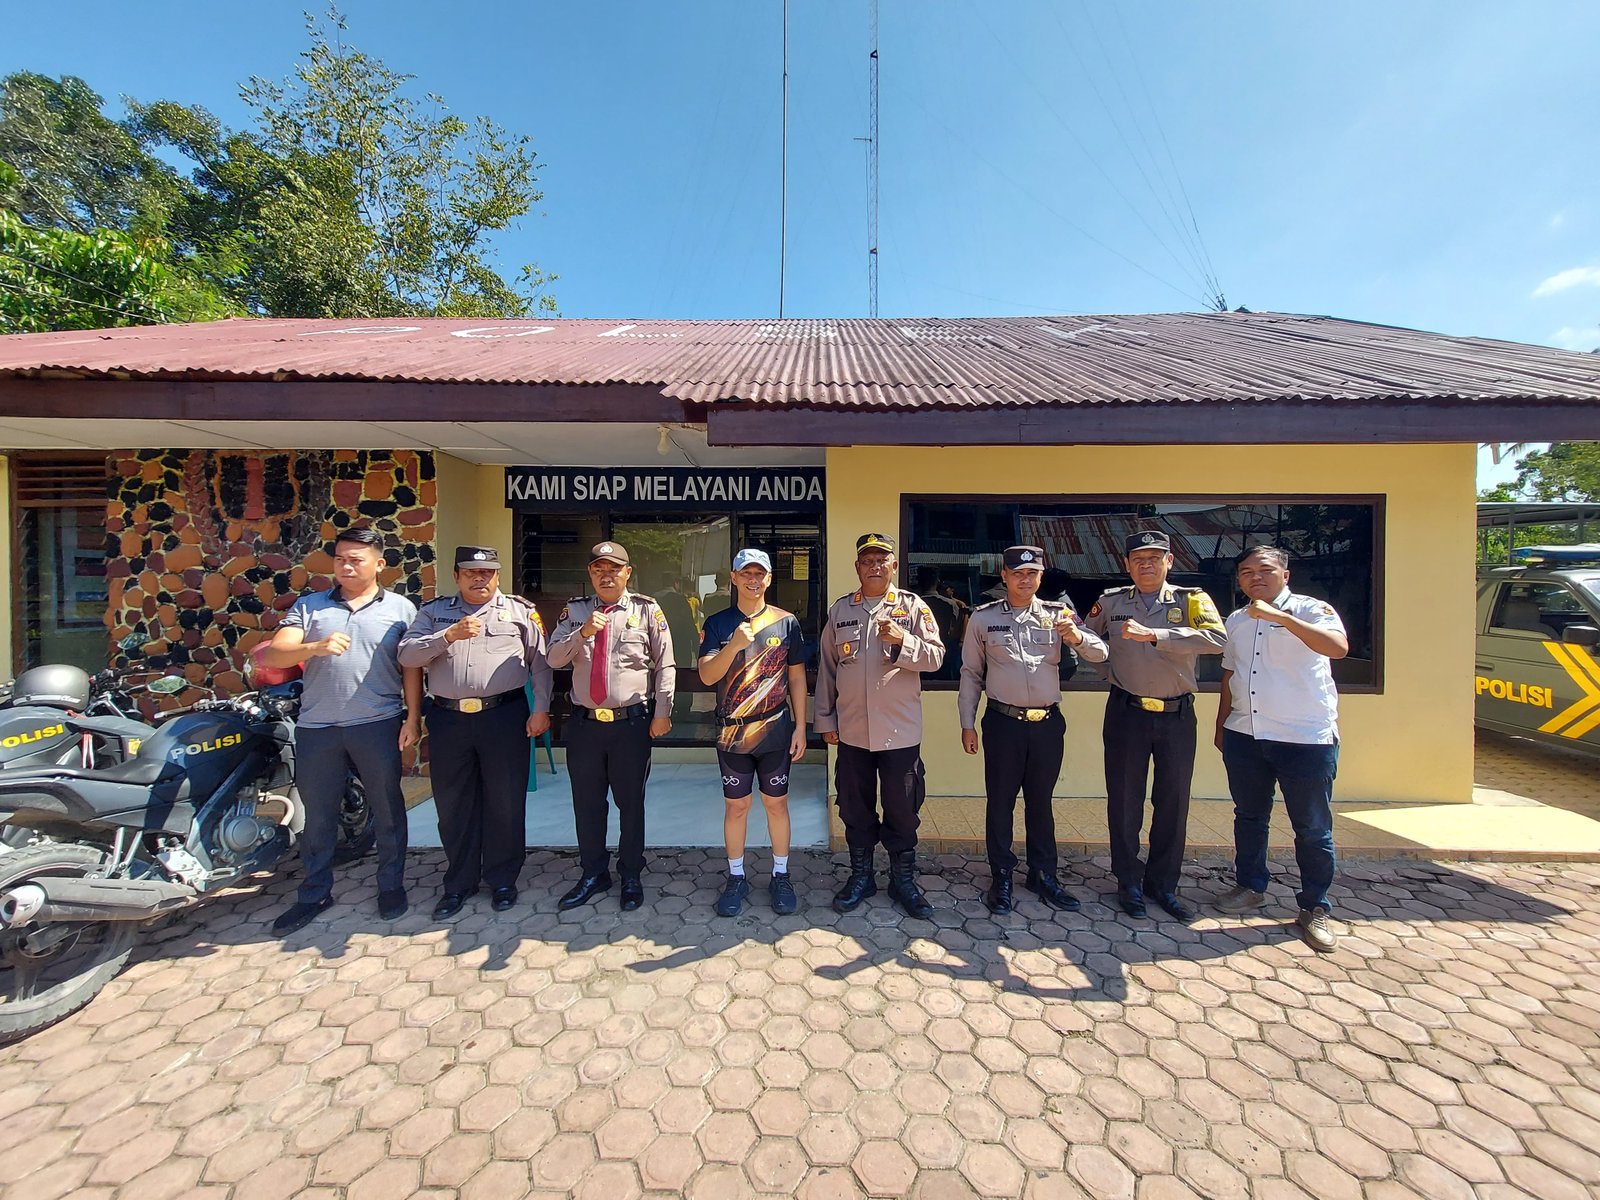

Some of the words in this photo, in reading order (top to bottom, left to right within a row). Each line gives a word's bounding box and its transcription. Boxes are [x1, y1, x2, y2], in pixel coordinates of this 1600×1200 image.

[507, 475, 566, 500] KAMI
[573, 475, 627, 501] SIAP
[634, 476, 750, 501] MELAYANI
[755, 476, 824, 501] ANDA
[1475, 676, 1553, 709] POLISI
[0, 723, 64, 749] OLISI
[170, 733, 242, 760] POLISI
